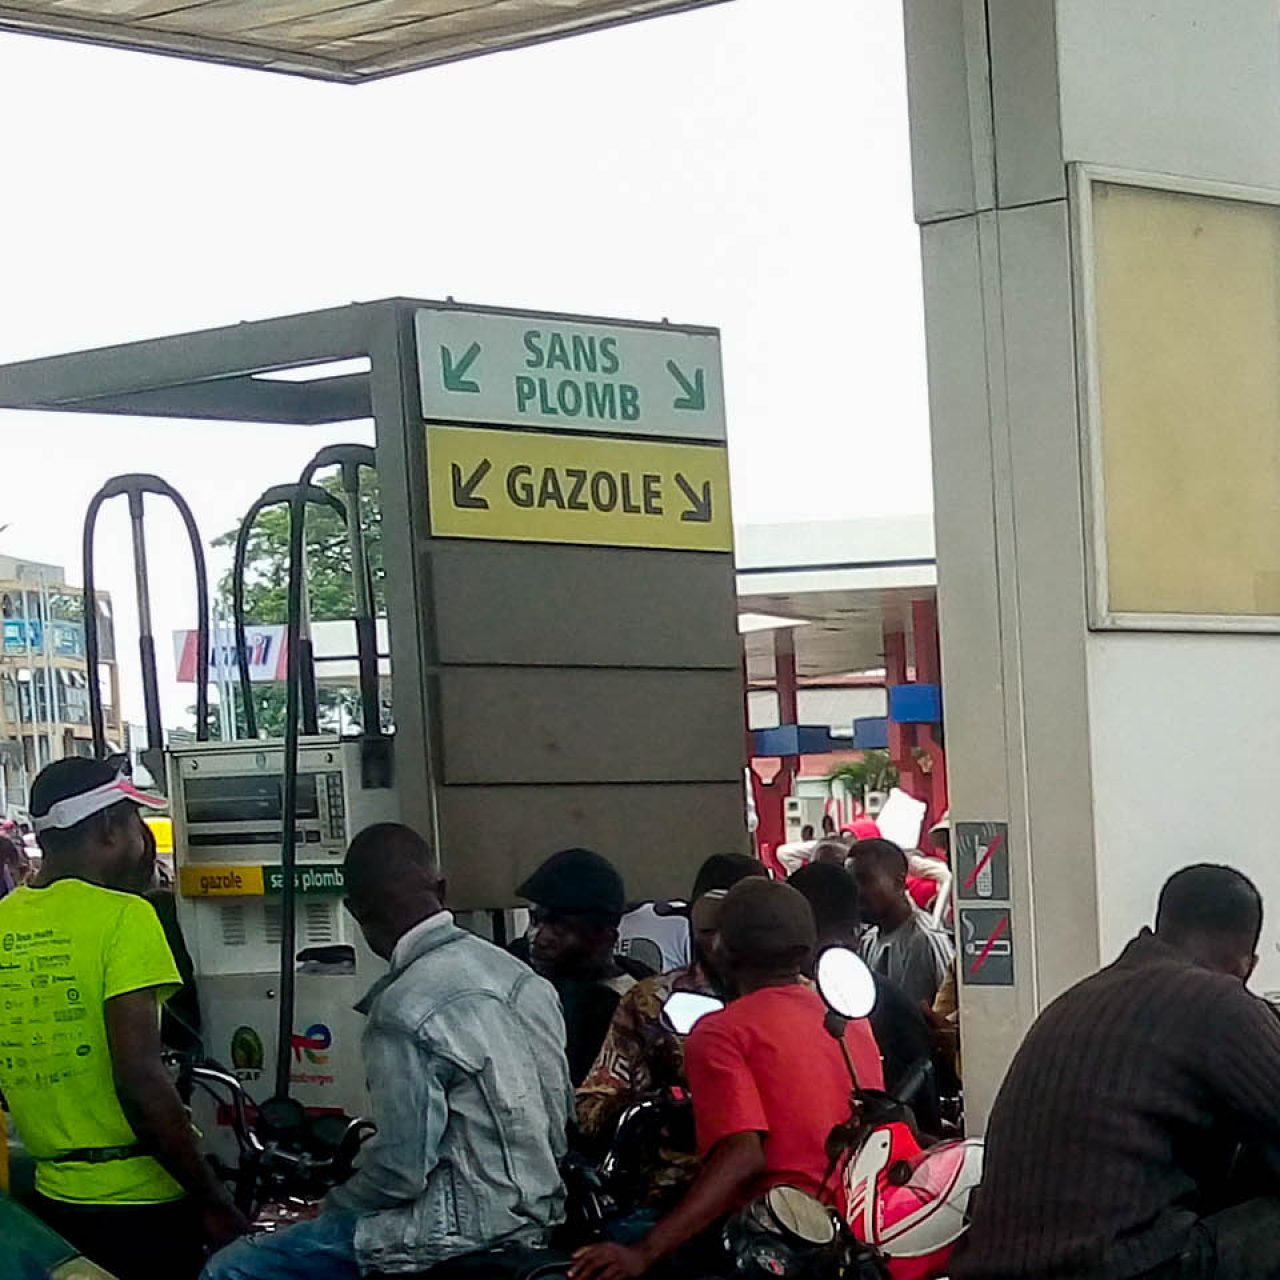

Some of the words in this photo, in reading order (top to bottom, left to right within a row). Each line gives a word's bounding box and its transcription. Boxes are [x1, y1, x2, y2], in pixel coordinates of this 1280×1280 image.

[523, 330, 620, 374] SANS
[515, 376, 641, 421] PLOMB
[506, 464, 664, 515] GAZOLE
[200, 871, 243, 893] gazole
[302, 868, 345, 891] plomb
